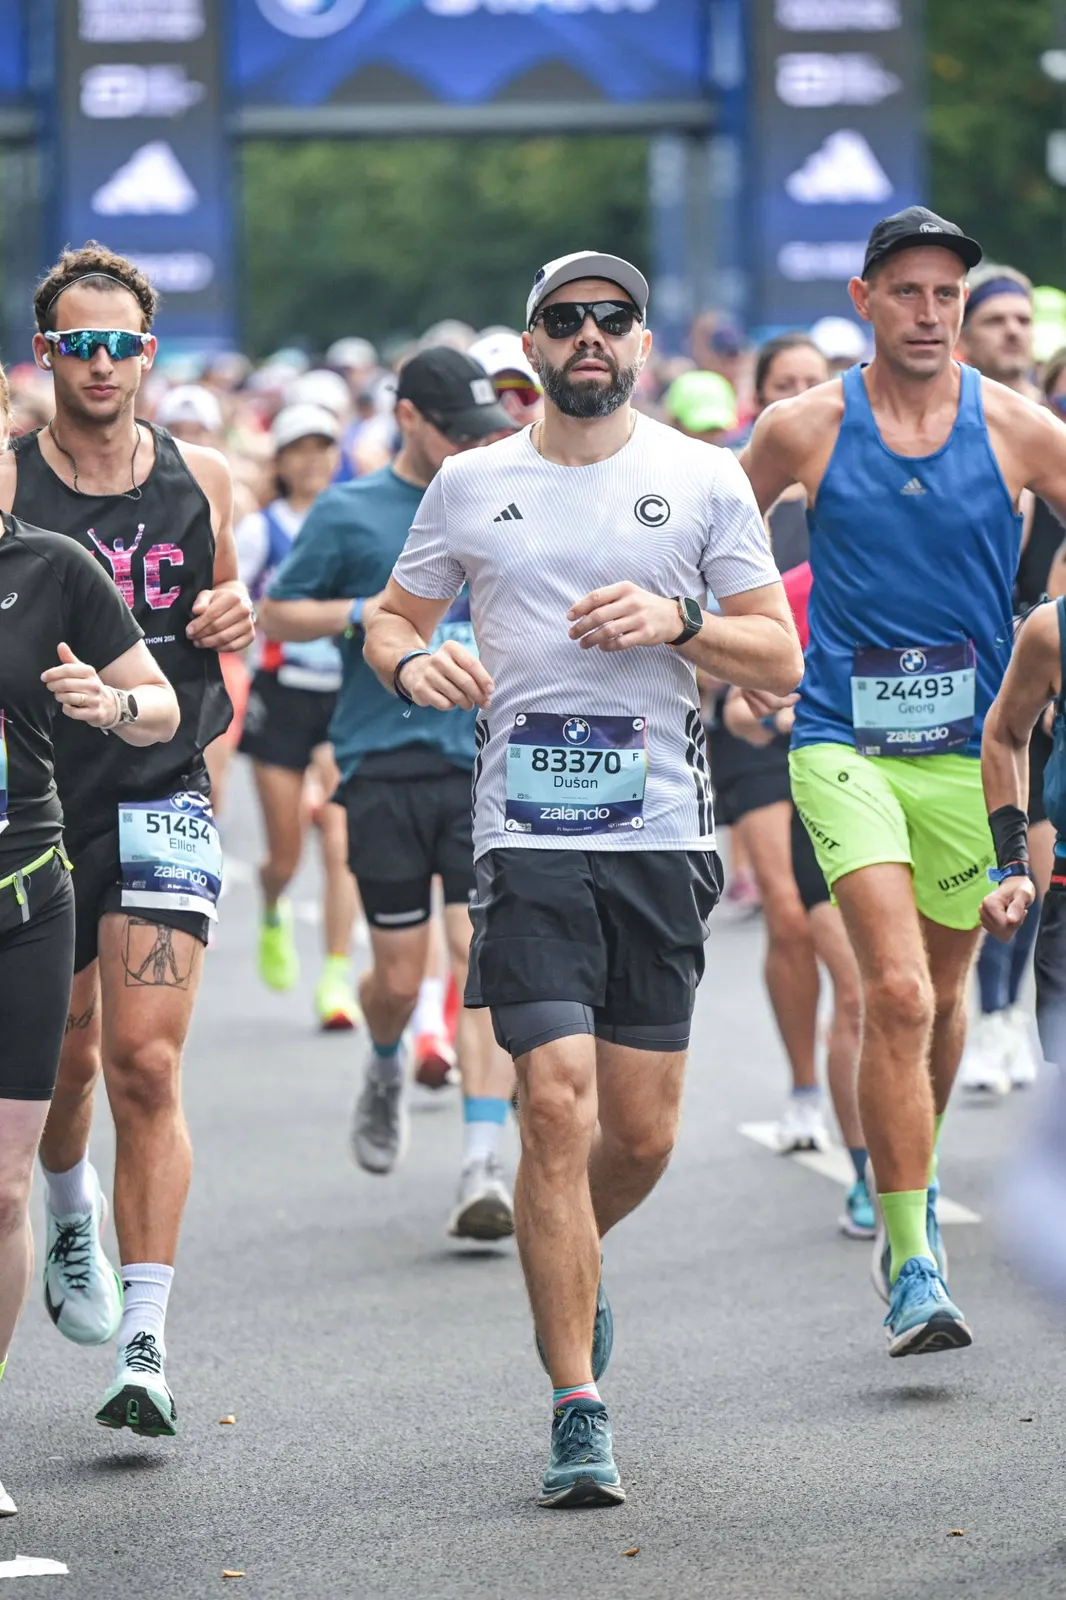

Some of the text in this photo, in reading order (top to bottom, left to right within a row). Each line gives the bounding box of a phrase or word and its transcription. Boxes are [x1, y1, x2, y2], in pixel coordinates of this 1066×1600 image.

[875, 676, 954, 701] 24493
[898, 702, 935, 714] Georg
[886, 727, 949, 743] zalando
[531, 748, 639, 774] 83370 F
[553, 775, 598, 789] Dušan
[540, 805, 610, 821] zalando
[146, 812, 210, 845] 51454
[169, 838, 196, 853] Elliot
[154, 865, 207, 887] zalando
